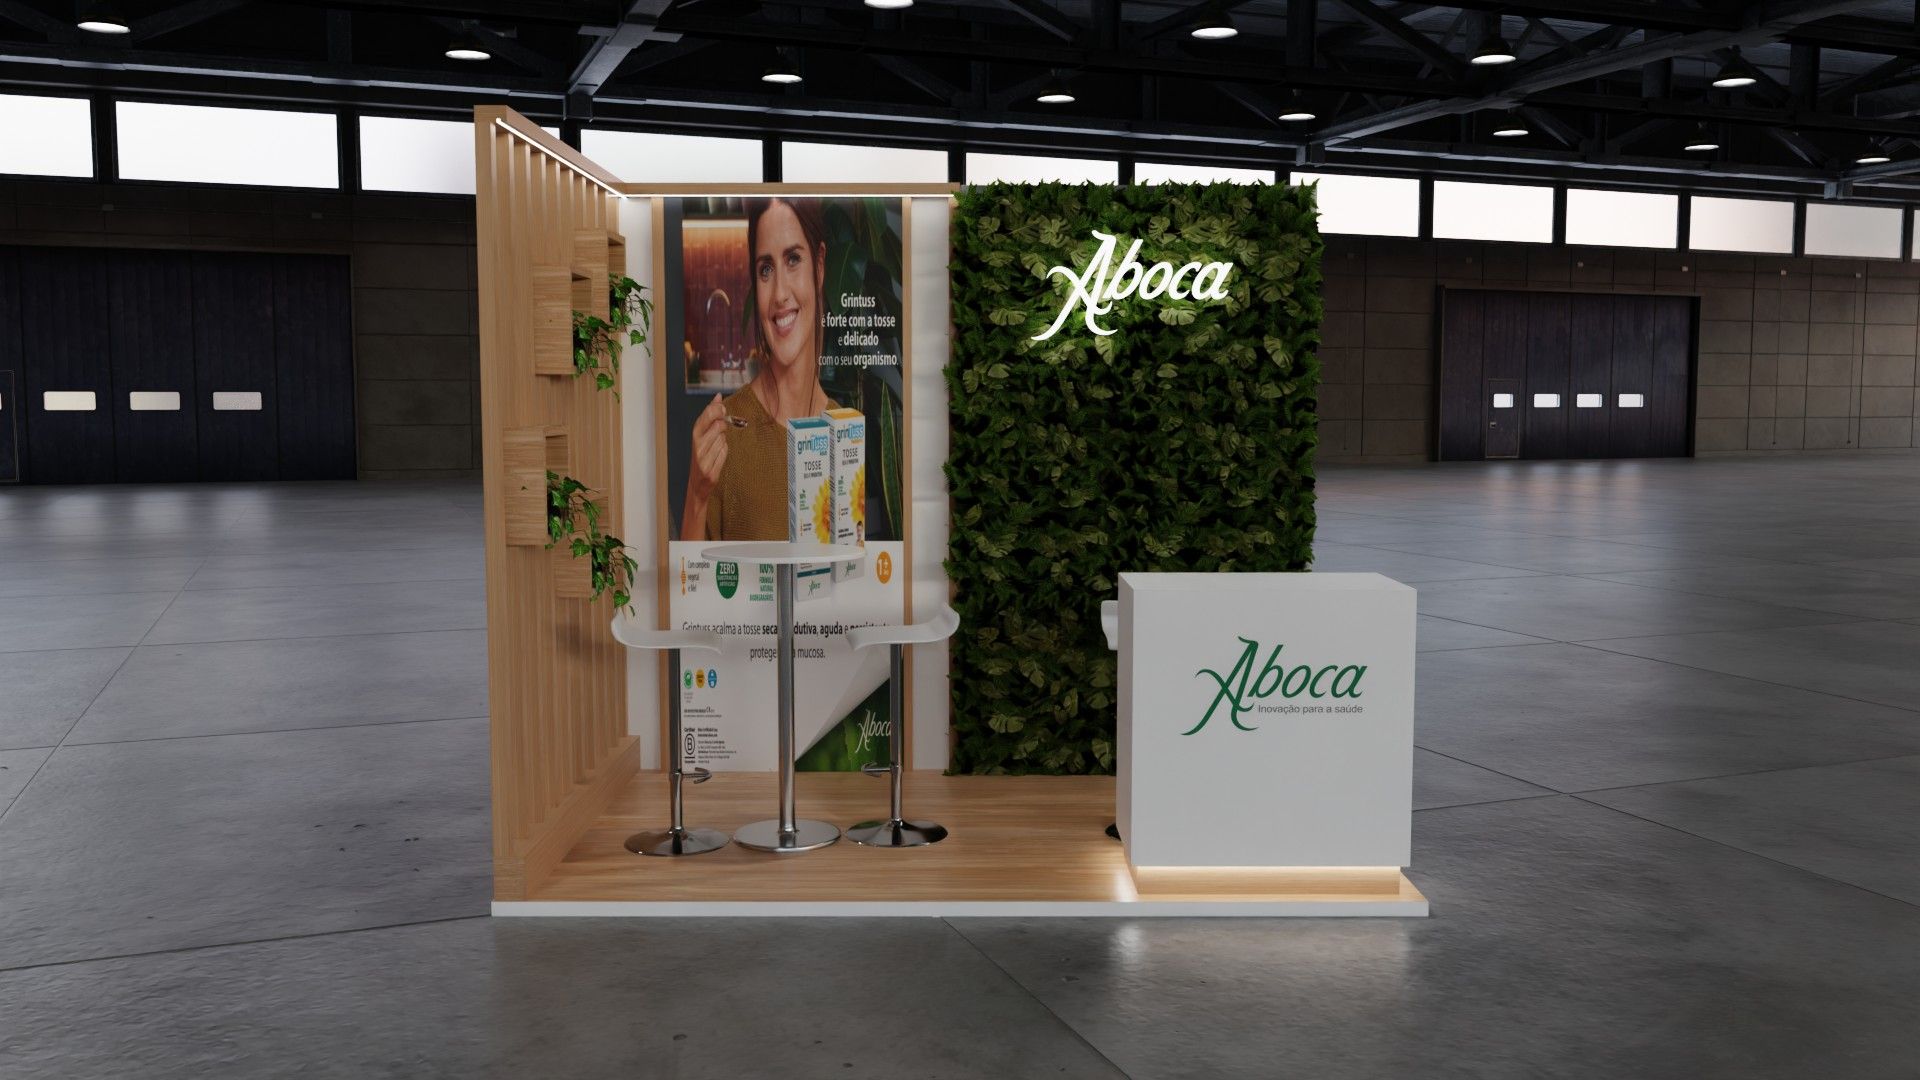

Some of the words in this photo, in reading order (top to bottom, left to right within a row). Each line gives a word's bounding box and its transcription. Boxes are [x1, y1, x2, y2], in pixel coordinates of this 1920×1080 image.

[1031, 229, 1234, 341] Aboca
[840, 292, 876, 308] Grintuss
[821, 314, 826, 328] é
[827, 312, 847, 327] forte
[848, 315, 866, 327] com
[867, 316, 873, 327] a
[874, 313, 896, 327] tosse
[838, 336, 843, 346] e
[844, 331, 879, 346] delicado
[819, 354, 833, 366] com
[834, 355, 839, 366] o
[840, 355, 852, 366] seu
[853, 351, 899, 369] organismo.
[842, 447, 858, 458] TOSSE
[804, 460, 822, 472] TOSSE
[719, 563, 736, 575] ZERO
[737, 624, 742, 635] a
[743, 623, 761, 635] tosse
[762, 624, 778, 635] seca
[820, 621, 843, 638] aguda
[750, 647, 777, 662] protege
[797, 648, 826, 658] mucosa.
[1181, 635, 1368, 736] Aboca
[1258, 704, 1300, 715] Inovação
[1302, 706, 1324, 715] para
[1334, 704, 1363, 713] saúde
